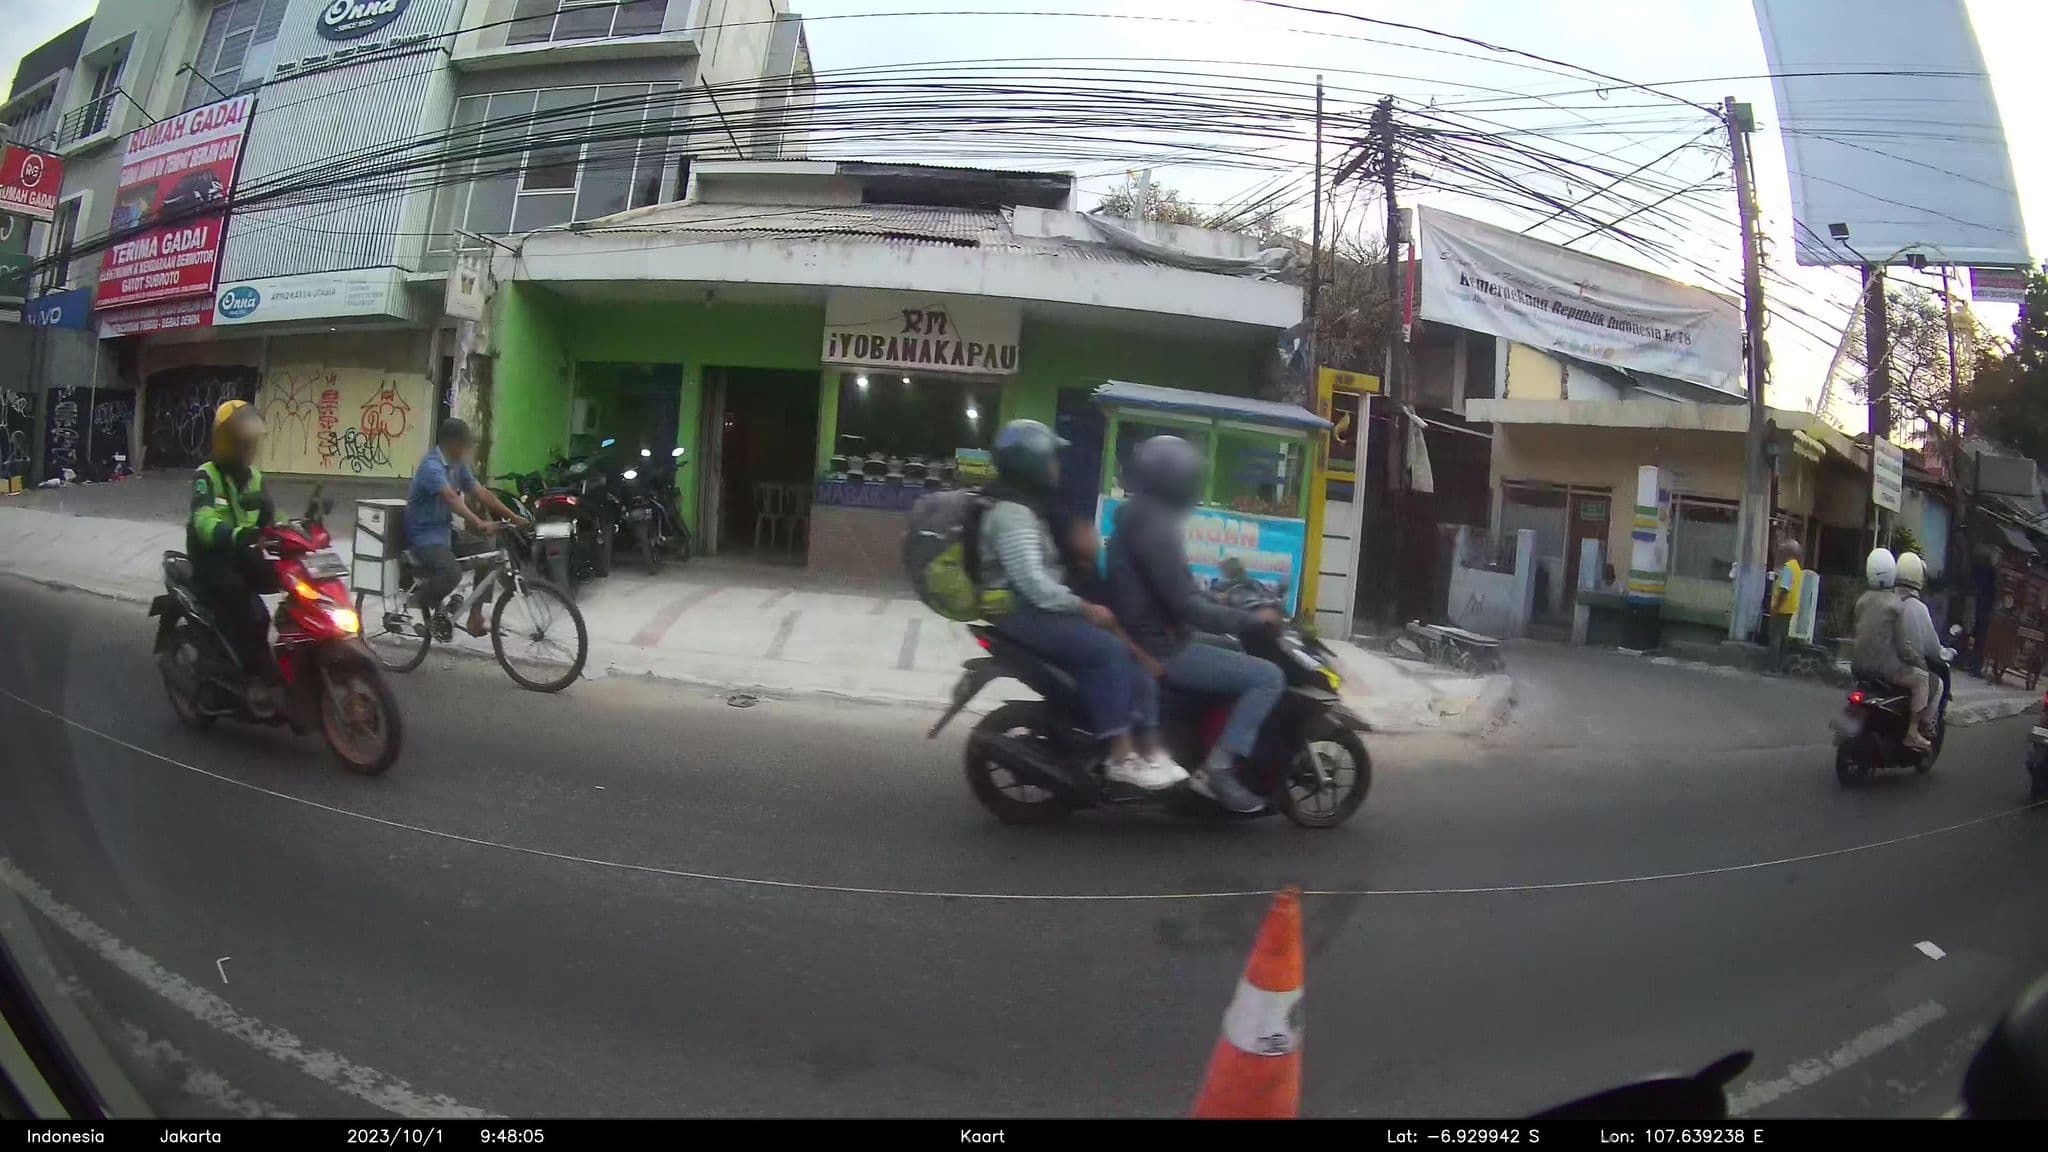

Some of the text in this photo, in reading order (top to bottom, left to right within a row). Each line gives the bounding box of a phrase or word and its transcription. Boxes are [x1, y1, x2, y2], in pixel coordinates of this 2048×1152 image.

[324, 0, 398, 25] Onna
[129, 98, 247, 154] RUMAH GADAI
[29, 191, 56, 209] GADAI
[112, 226, 208, 265] TERIMA GADAI
[122, 270, 180, 293] GATOT SUBROTO
[222, 291, 257, 311] Onna
[901, 309, 948, 335] RM
[1552, 300, 1606, 327] Republik
[1607, 315, 1662, 341] Indonesia
